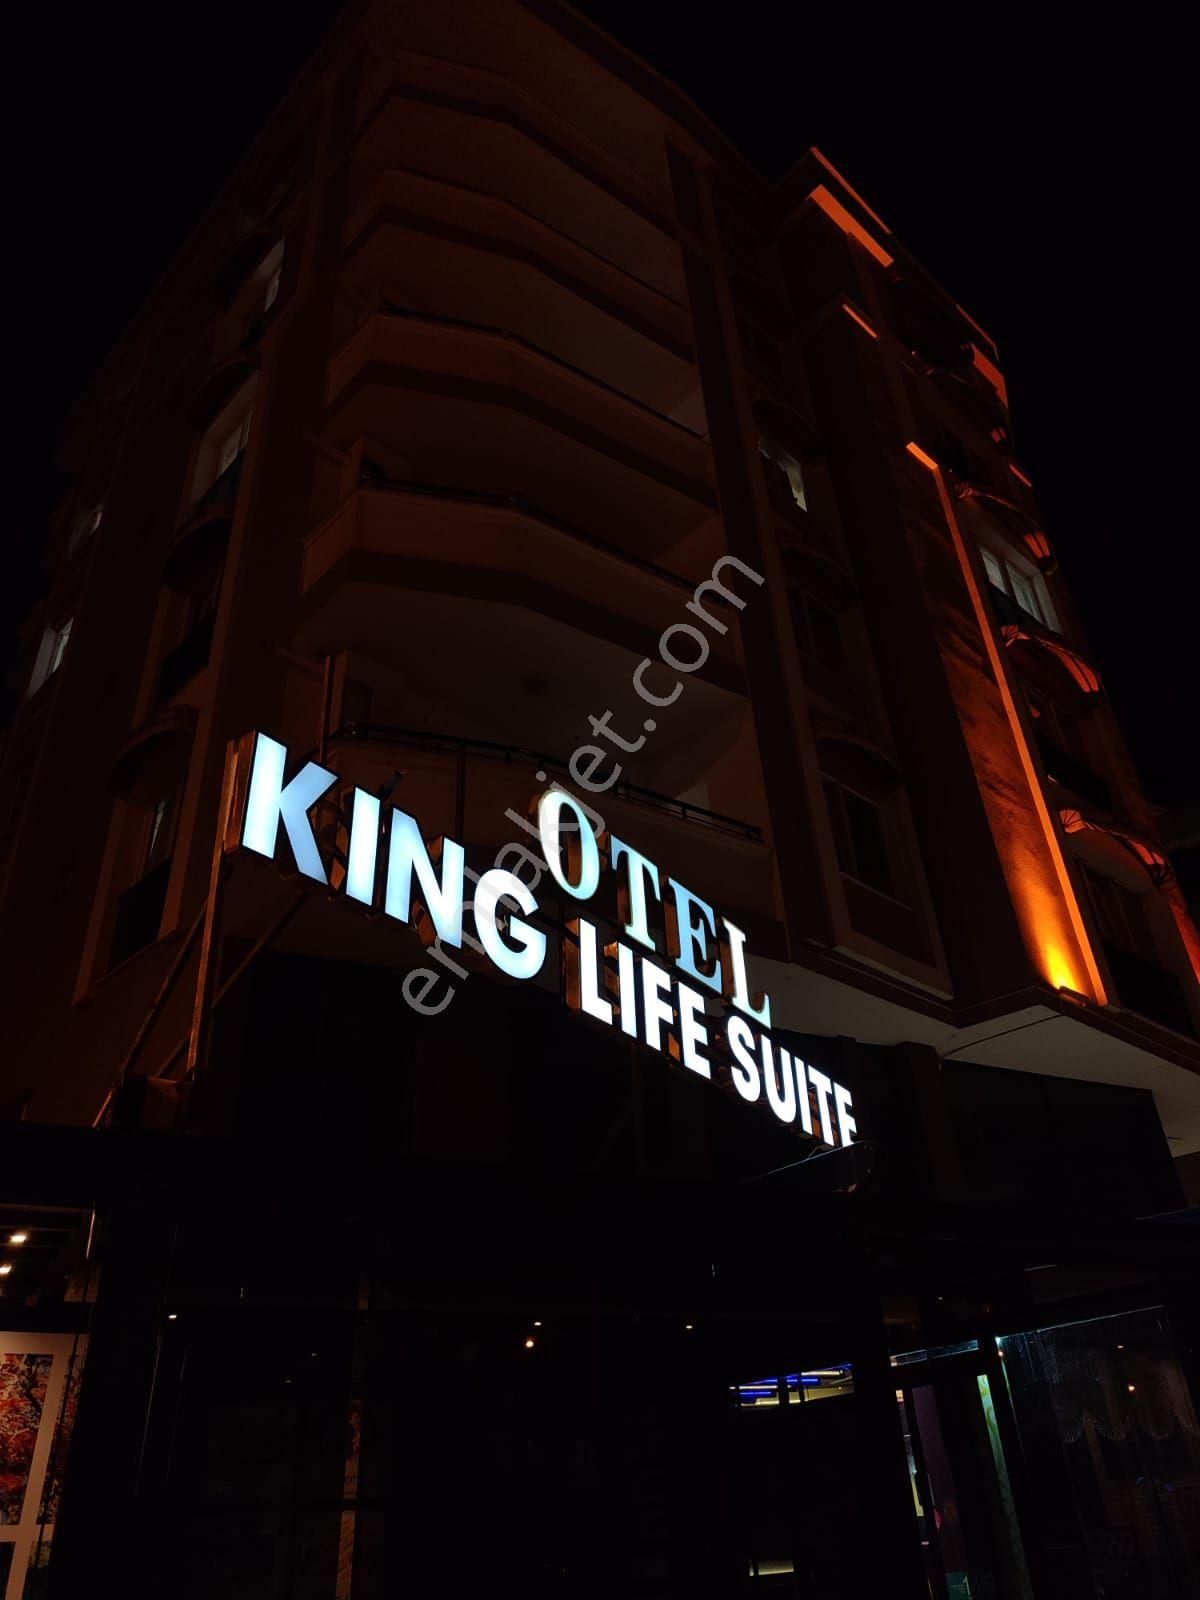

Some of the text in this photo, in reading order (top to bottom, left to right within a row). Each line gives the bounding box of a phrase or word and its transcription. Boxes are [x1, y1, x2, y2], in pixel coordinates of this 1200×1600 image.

[242, 732, 858, 1148] KING LIFE SUITE
[538, 789, 772, 1030] OTEL
